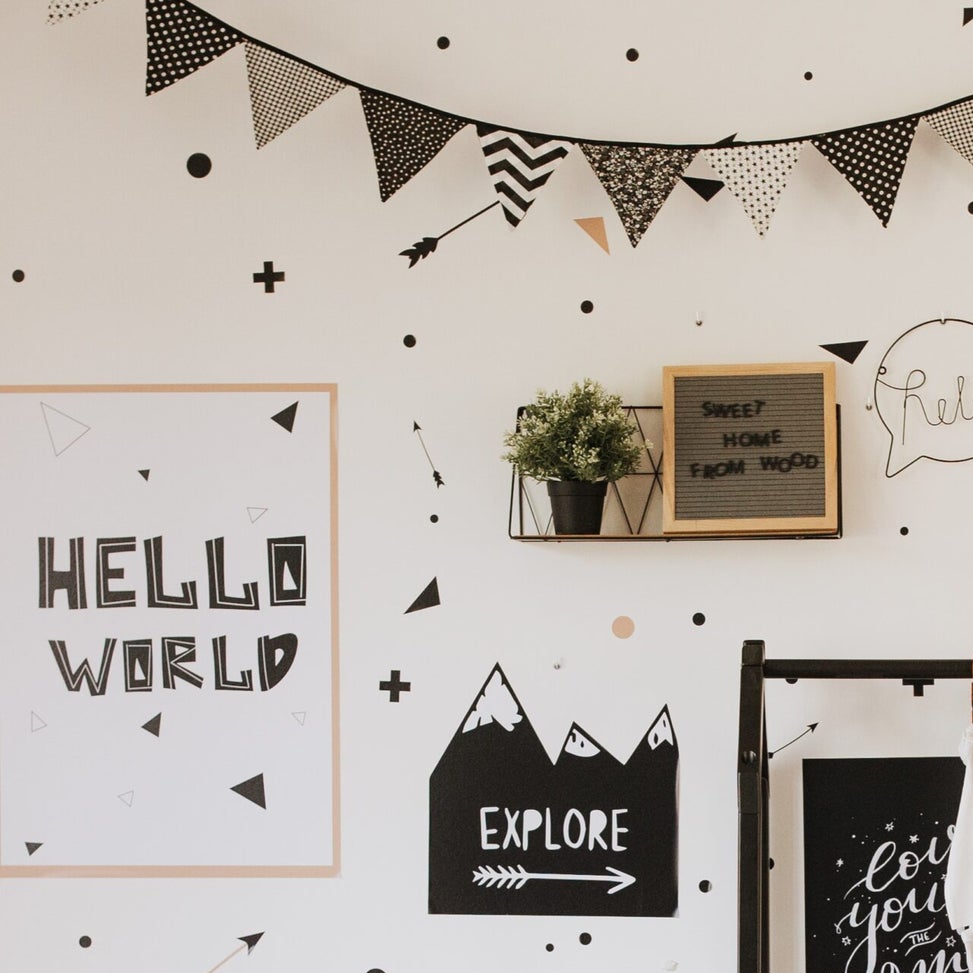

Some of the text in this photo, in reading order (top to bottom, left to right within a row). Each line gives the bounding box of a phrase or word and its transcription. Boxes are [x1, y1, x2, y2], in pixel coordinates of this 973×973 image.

[702, 399, 766, 418] SWEET
[723, 429, 782, 447] HOME
[690, 452, 818, 479] FROM WOOD
[38, 535, 307, 611] HELLO
[48, 632, 299, 697] WORLD
[480, 806, 628, 852] EXPLORE
[909, 931, 930, 945] THE
